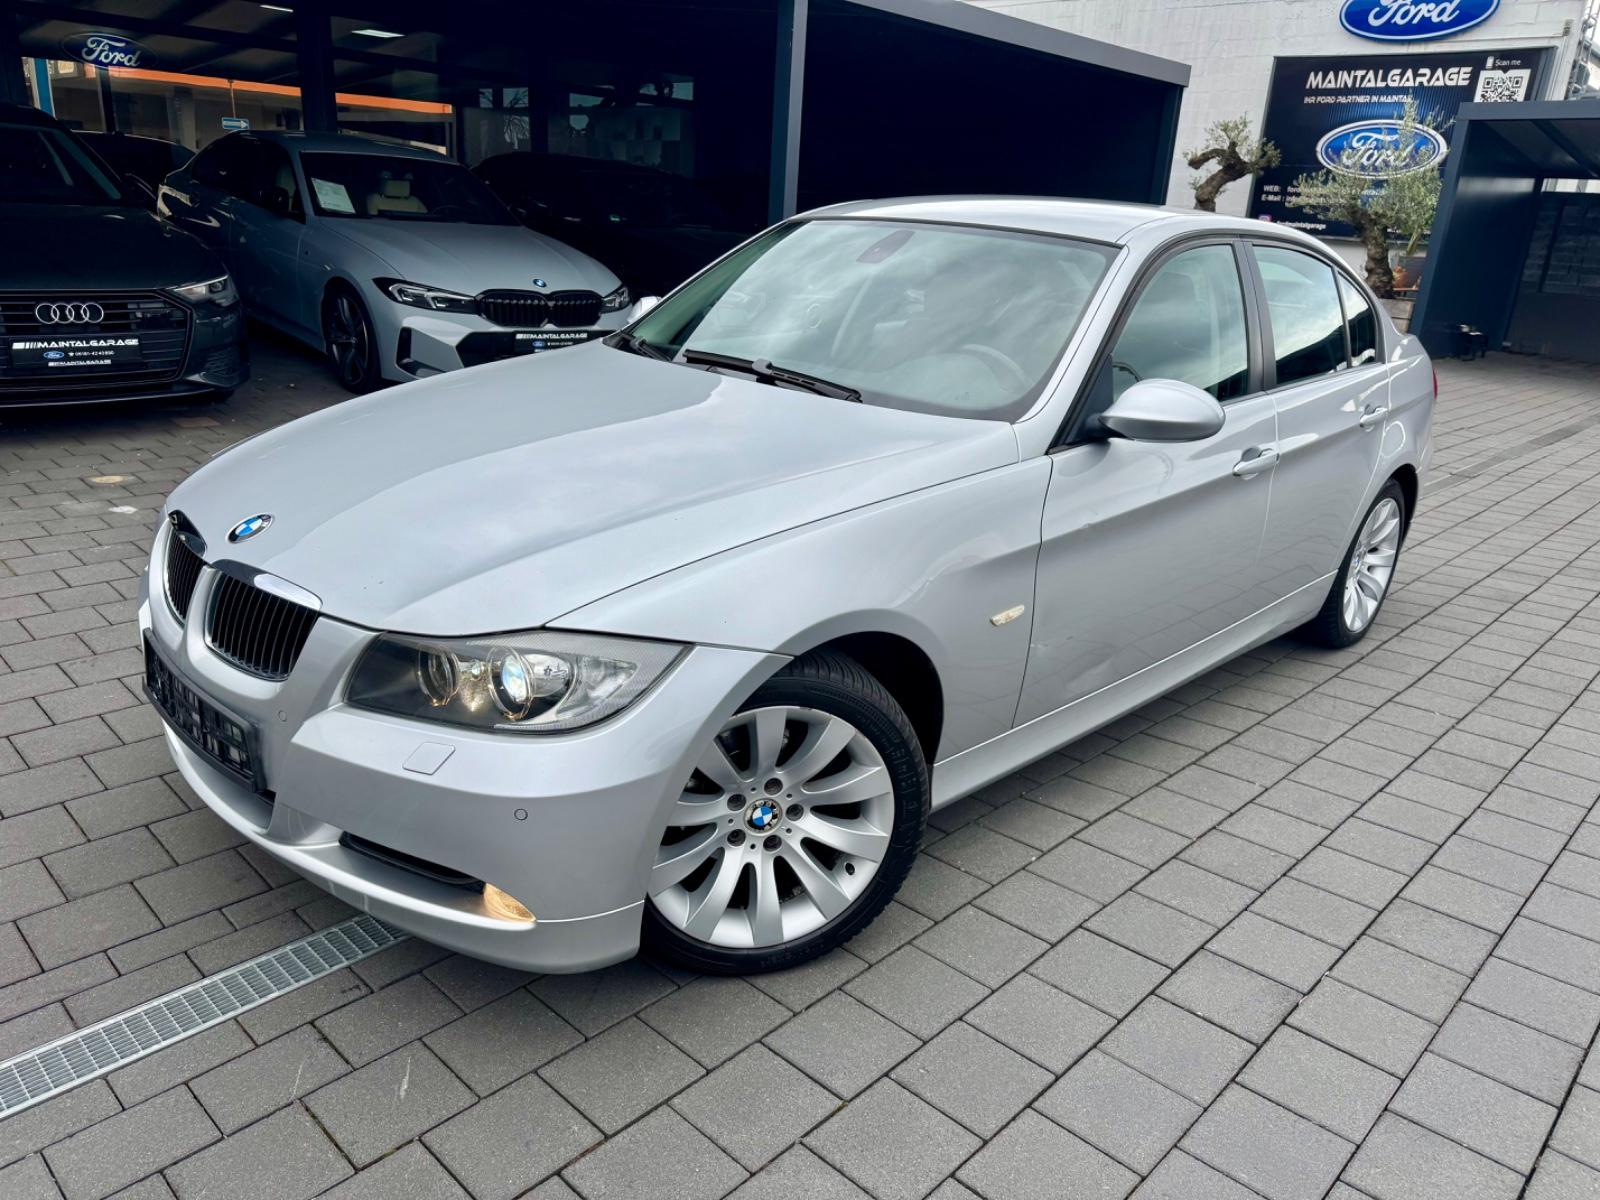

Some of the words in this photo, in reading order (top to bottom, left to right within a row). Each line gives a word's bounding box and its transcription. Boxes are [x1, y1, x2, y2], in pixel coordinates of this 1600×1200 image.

[81, 36, 141, 67] Ford
[1305, 67, 1473, 89] MAINTALGARAGE
[1304, 96, 1317, 104] IHR
[1316, 96, 1337, 104] FORD
[1336, 95, 1371, 103] PARTNER
[1371, 95, 1380, 103] IN
[1261, 194, 1281, 202] E-Mail
[38, 339, 139, 348] MAINTALGARAGE
